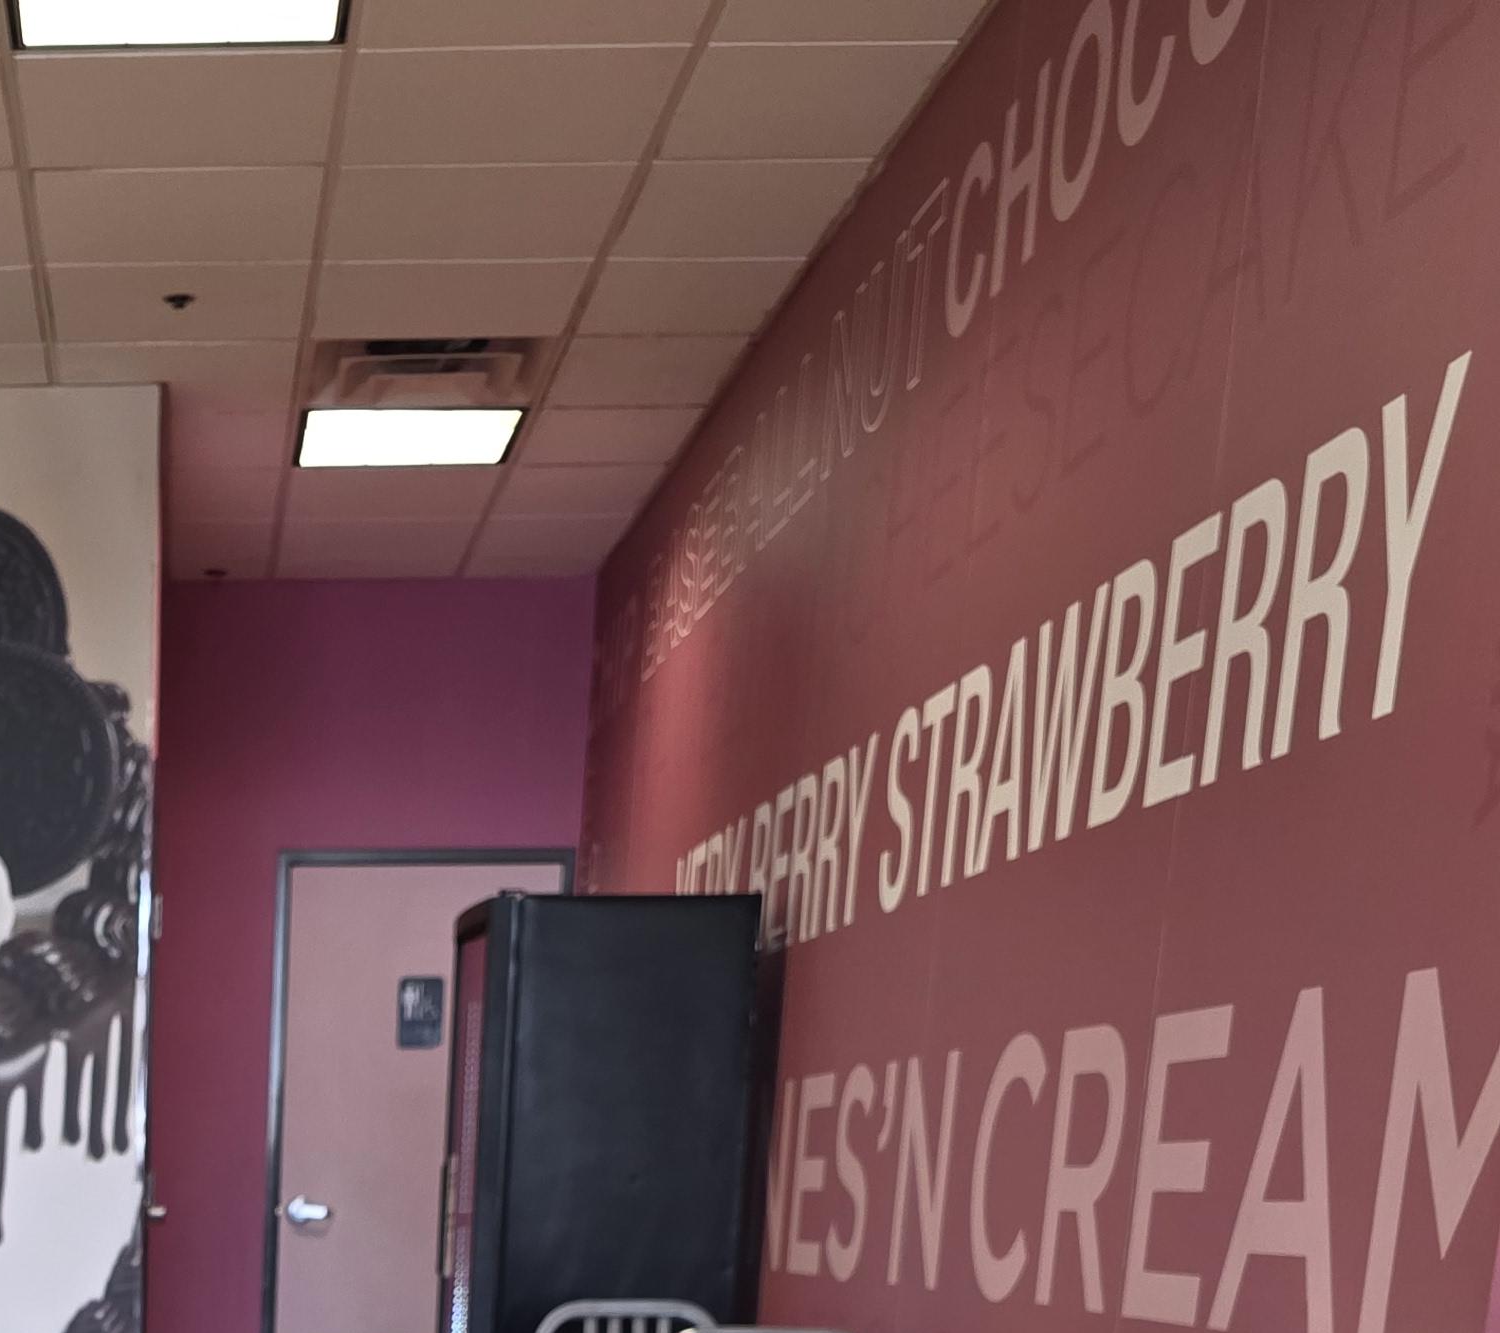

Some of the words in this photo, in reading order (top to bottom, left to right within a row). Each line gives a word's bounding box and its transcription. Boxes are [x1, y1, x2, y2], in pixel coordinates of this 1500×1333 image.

[945, 0, 1248, 338] CHOC
[749, 732, 879, 954] BERRY
[879, 349, 1473, 914] STRAWBERRY
